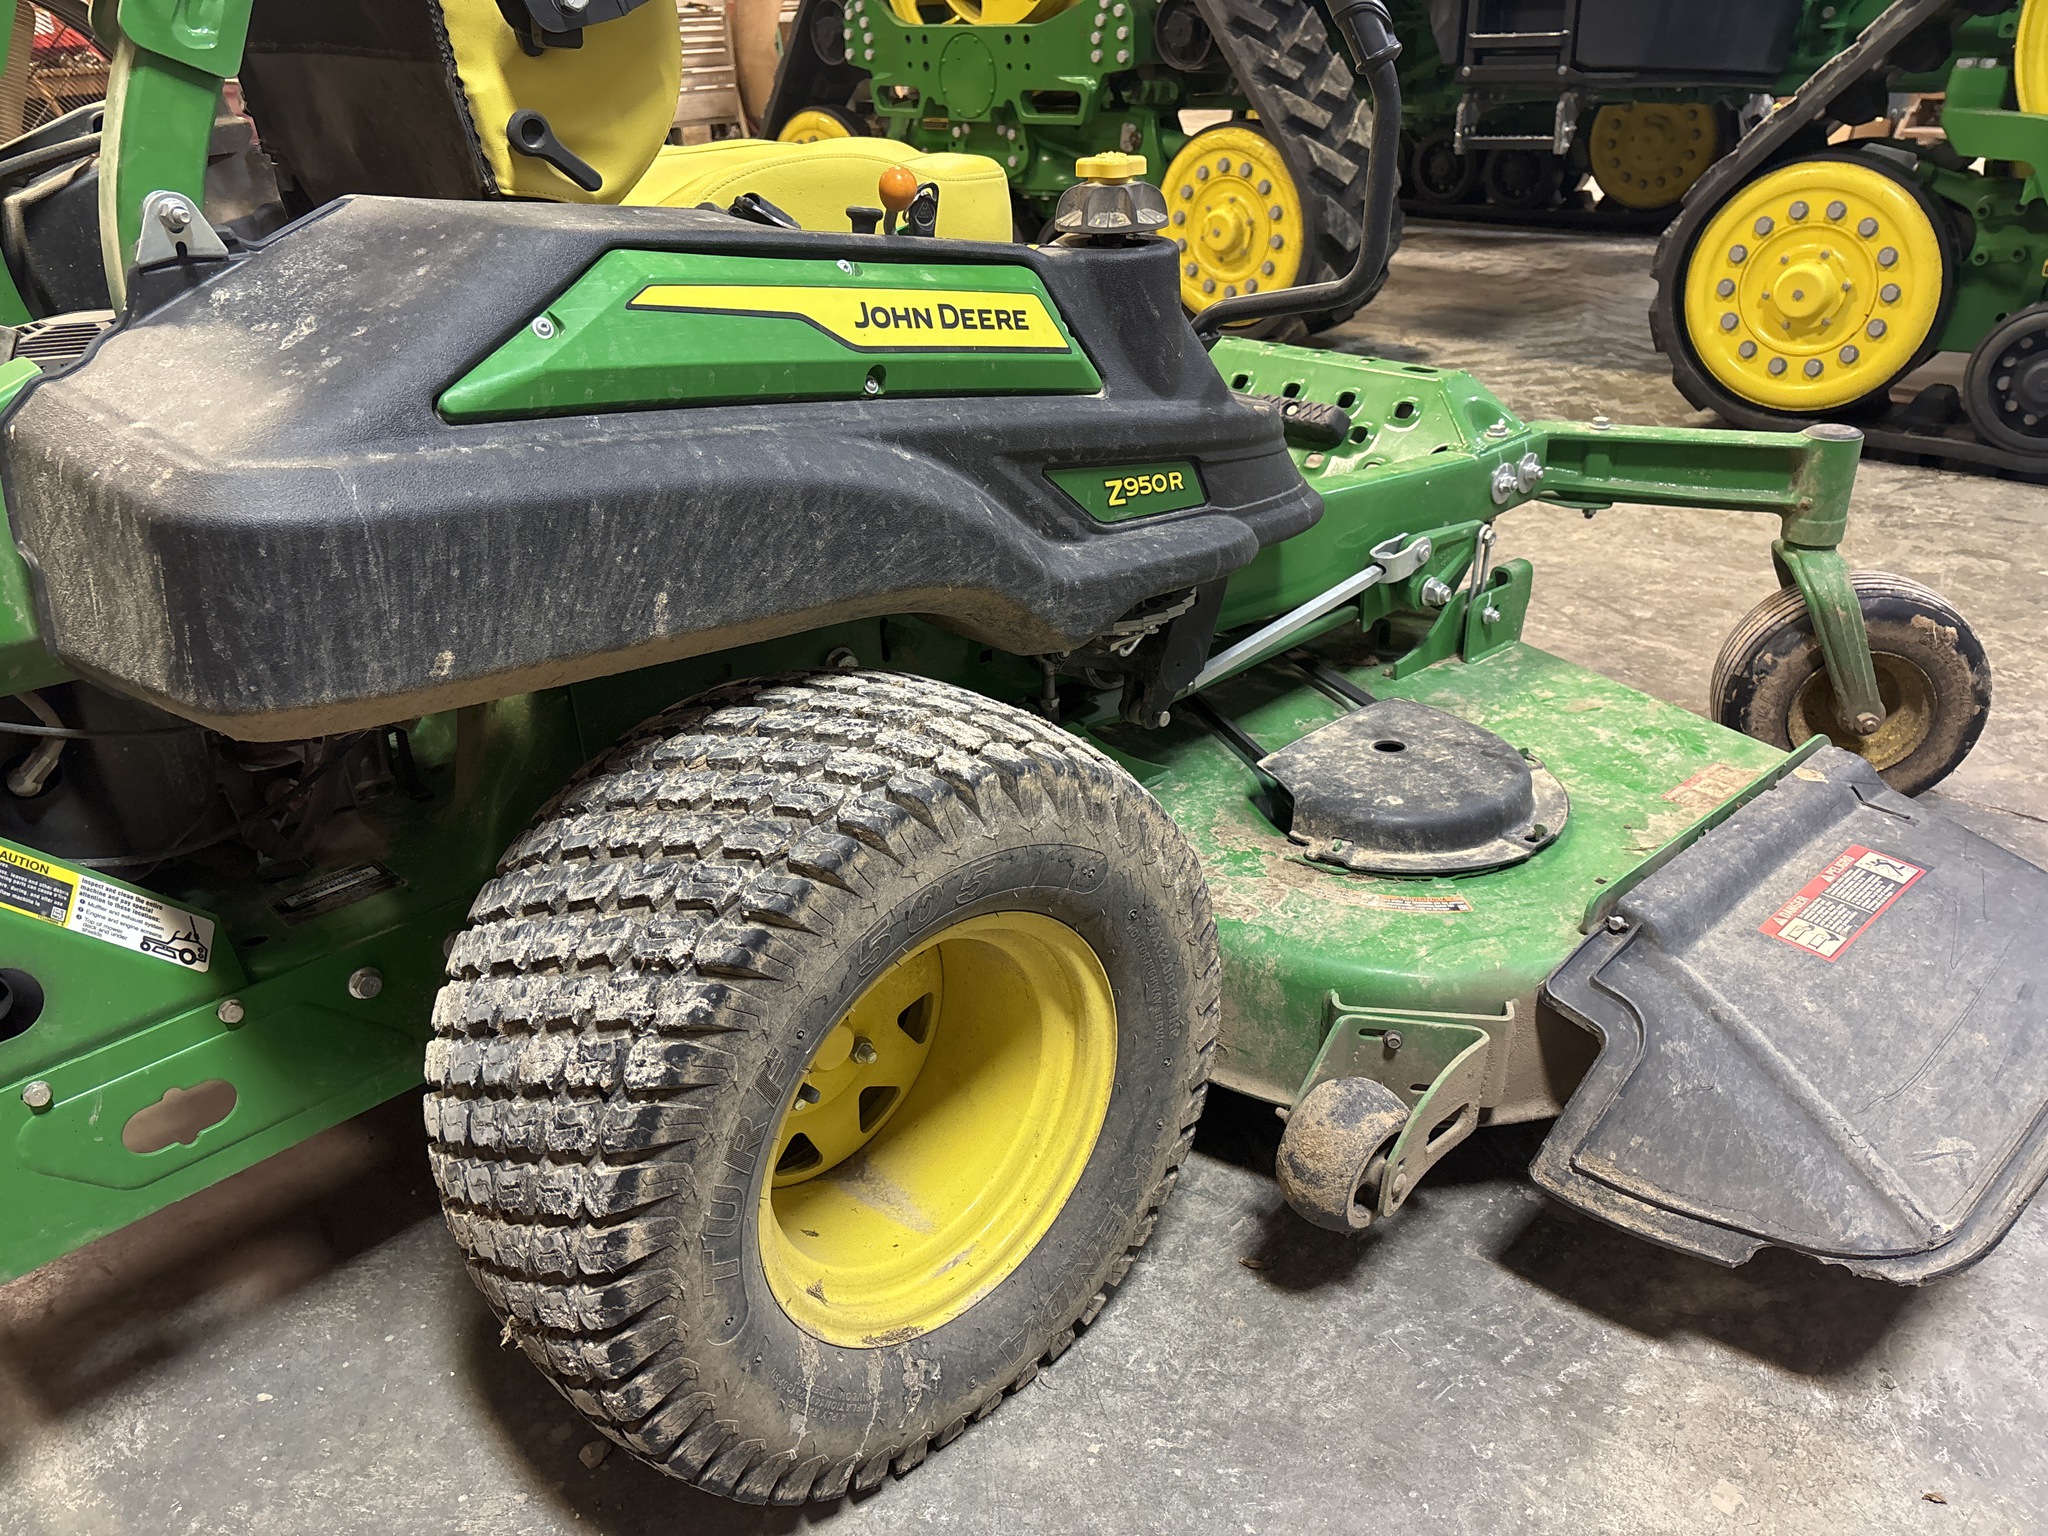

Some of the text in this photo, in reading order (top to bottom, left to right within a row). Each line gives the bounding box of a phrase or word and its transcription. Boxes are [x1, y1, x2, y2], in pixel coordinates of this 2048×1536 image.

[854, 302, 1030, 330] JOHN DEERE
[1104, 471, 1185, 507] Z950R
[1828, 855, 1856, 879] PELIGRO
[28, 877, 39, 885] and
[39, 881, 53, 890] other
[53, 886, 70, 896] debris
[29, 891, 40, 899] and
[40, 895, 53, 903] after
[38, 887, 53, 896] cause
[80, 884, 154, 914] machine and pay special
[81, 878, 163, 910] Inspect and clean the entire
[79, 891, 106, 905] attention
[107, 899, 114, 907] to
[115, 901, 131, 912] these
[1779, 895, 1811, 922] DANGER
[84, 916, 95, 926] Top
[103, 923, 123, 934] mower
[85, 909, 107, 920] Engine
[107, 915, 119, 925] and
[119, 920, 139, 932] engine
[140, 927, 163, 940] screens
[87, 900, 108, 912] Muffler
[108, 907, 120, 916] and
[120, 912, 143, 925] exhaust
[144, 920, 165, 932] system
[858, 855, 995, 977] 505
[81, 926, 103, 938] shields
[82, 921, 128, 941] deck and under
[1126, 923, 1165, 1056] NOT FOR HIGHWAY SERVICE
[702, 1046, 787, 1297] TURF
[998, 1153, 1154, 1367] KENDA
[820, 1410, 837, 1422] PLY
